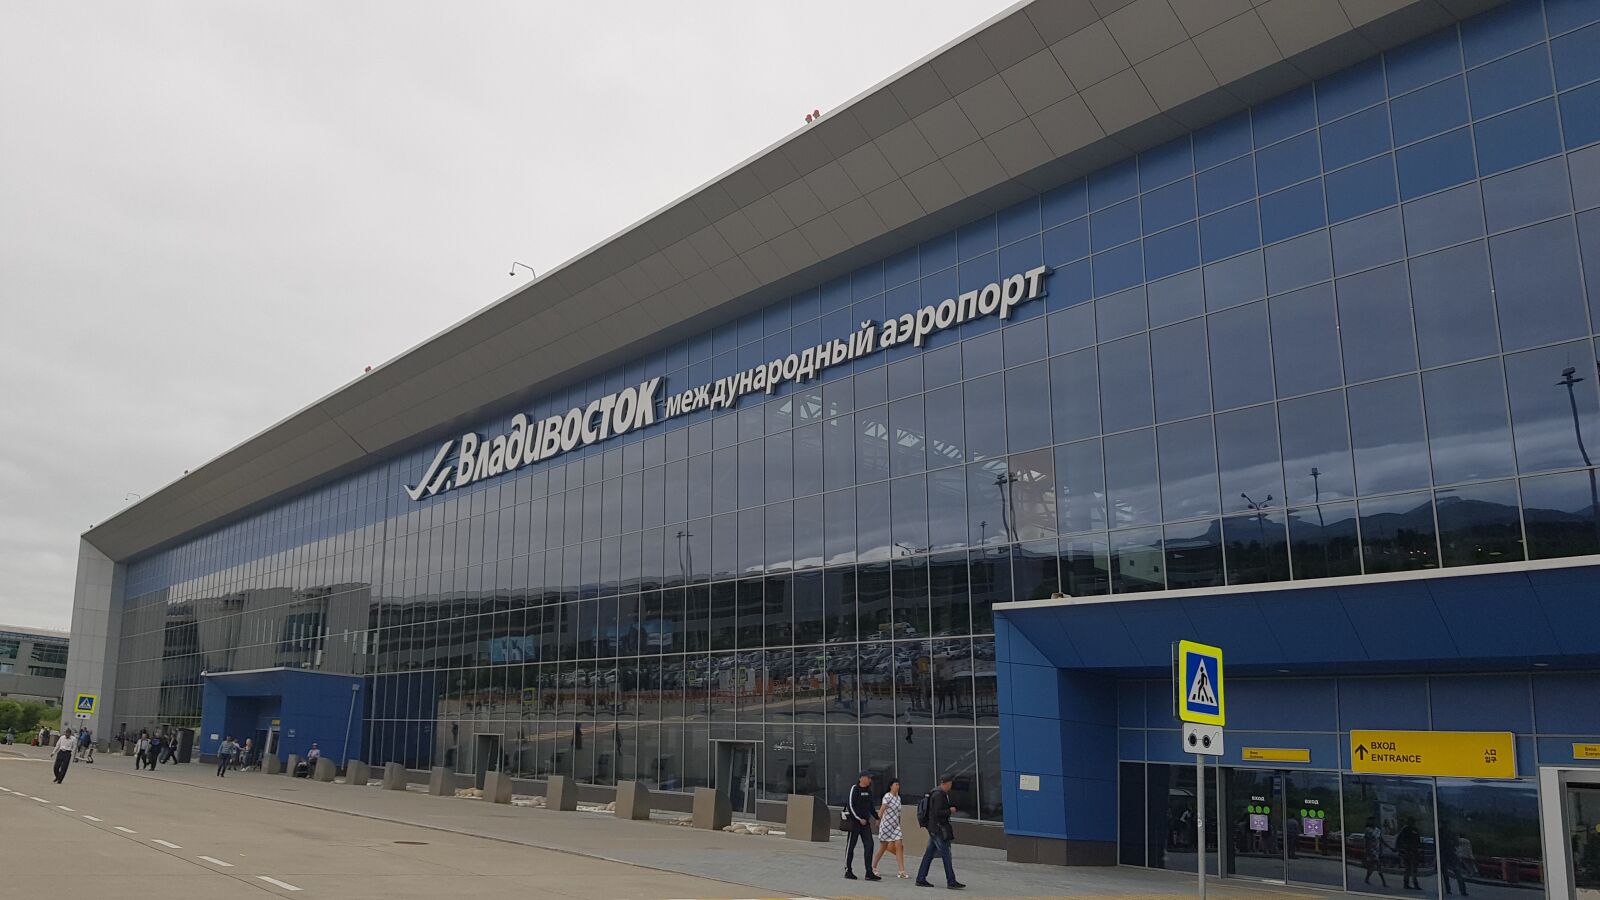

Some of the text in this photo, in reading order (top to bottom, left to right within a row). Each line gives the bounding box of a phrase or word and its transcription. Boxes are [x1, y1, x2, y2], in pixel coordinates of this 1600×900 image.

[455, 264, 1050, 487] Владивосток международный аэропорт
[1371, 742, 1396, 751] ВХОД
[1371, 754, 1422, 763] ENTRANCE
